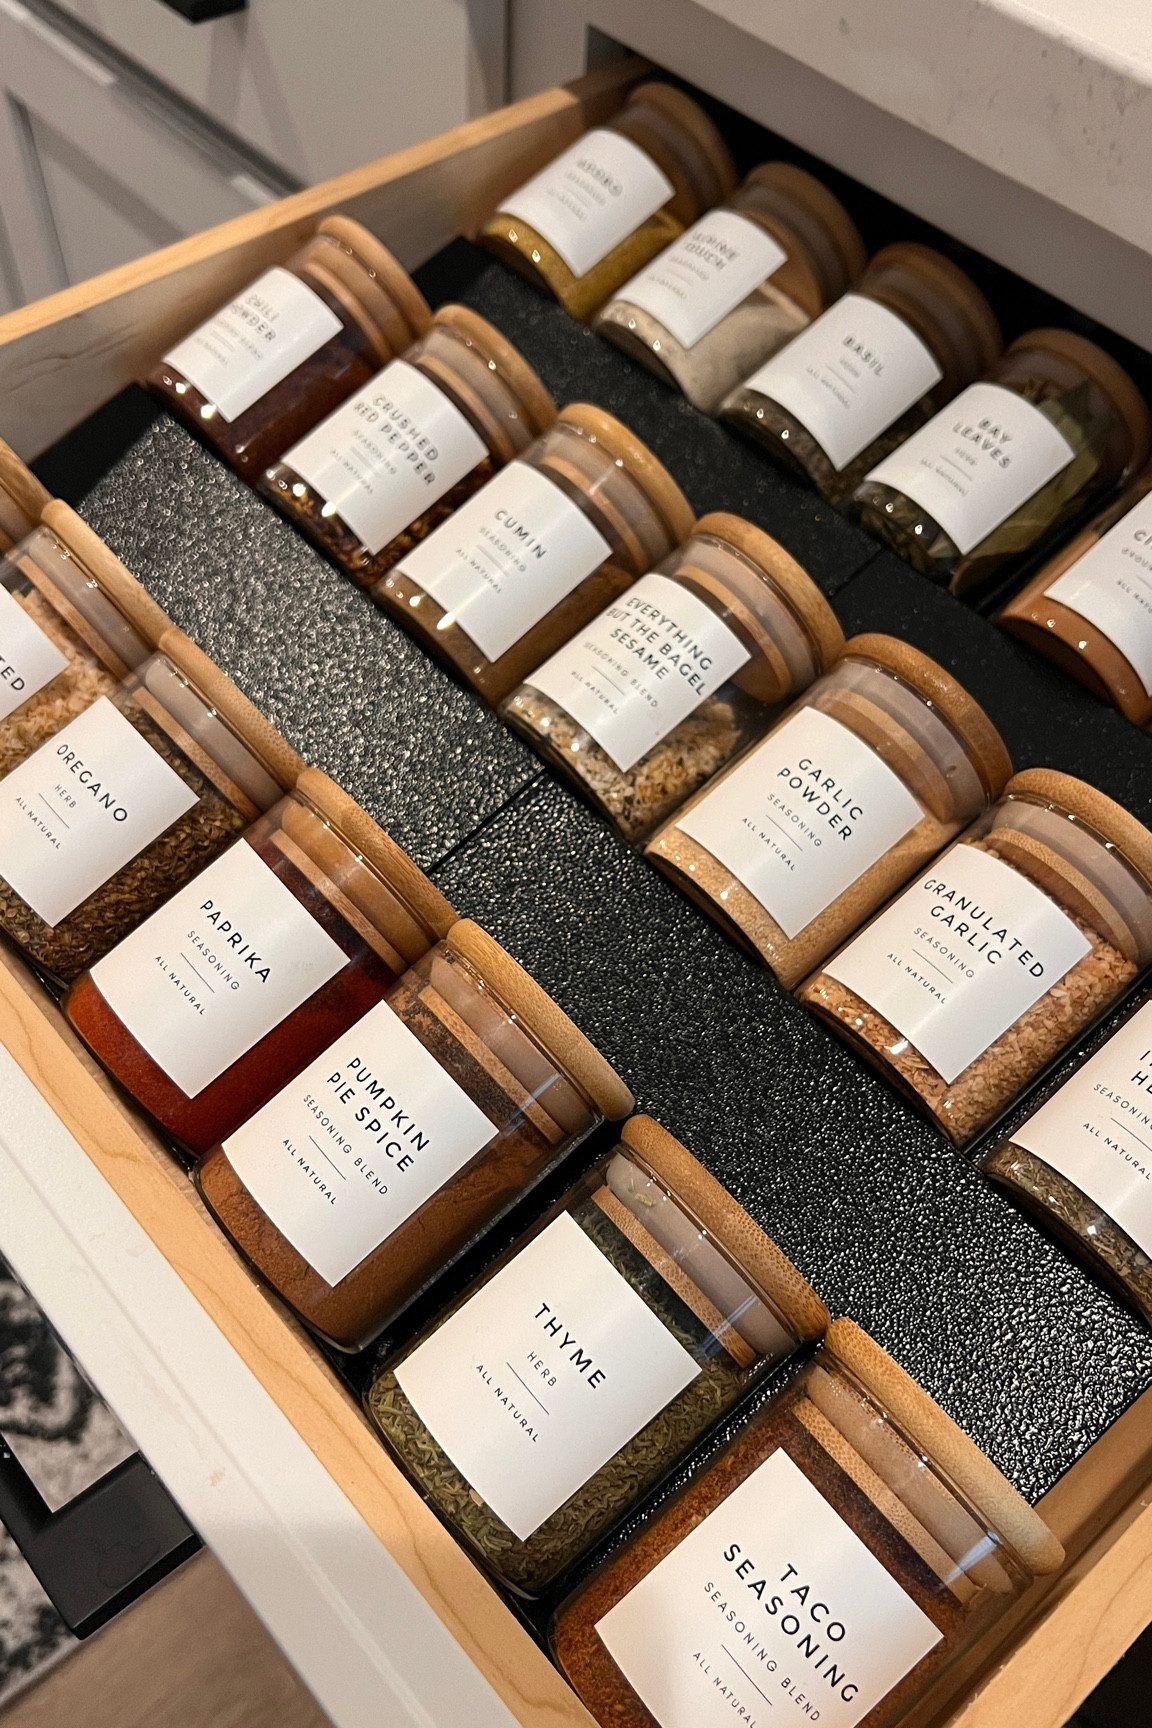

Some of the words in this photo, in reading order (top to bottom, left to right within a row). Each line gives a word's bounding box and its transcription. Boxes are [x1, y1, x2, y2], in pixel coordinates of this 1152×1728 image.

[843, 336, 884, 377] BASIL
[354, 401, 380, 424] RED
[380, 424, 436, 486] PEPPER
[372, 394, 438, 461] CRUSHED
[952, 422, 1011, 469] LEAVES
[978, 418, 1012, 444] BAY
[480, 527, 527, 572] SEASONING
[494, 509, 547, 560] CUMIN
[607, 608, 631, 622] BUT
[631, 618, 660, 644] THE
[659, 643, 708, 696] BAGEL
[610, 628, 670, 680] SESAME
[626, 598, 712, 671] EVERYTHING
[571, 670, 584, 684] ALL
[585, 682, 620, 715] NATURAL
[584, 642, 629, 678] SEASONING
[630, 678, 658, 708] BLEND
[54, 784, 76, 810] HERB
[56, 744, 128, 822] OREGANO
[777, 768, 852, 841] POWDER
[798, 758, 863, 821] GARLIC
[16, 797, 27, 812] ALL
[26, 810, 62, 850] NATURAL
[741, 817, 758, 832] ALL
[758, 832, 796, 871] NATURAL
[767, 794, 822, 847] SEASONING
[200, 900, 272, 984] PAPRIKA
[913, 927, 975, 979] SEASONING
[923, 879, 1044, 978] GRANULATED
[930, 905, 1002, 965] GARLIC
[155, 955, 168, 972] ALL
[168, 972, 206, 1016] NATURAL
[187, 930, 240, 991] SEASONING
[886, 952, 903, 967] ALL
[904, 966, 946, 1004] NATURAL
[326, 1071, 356, 1105] PIE
[354, 1106, 415, 1173] SPICE
[346, 1057, 430, 1152] PUMPKIN
[1093, 1083, 1152, 1130] SEASONIN
[282, 1138, 296, 1156] ALL
[297, 1157, 338, 1206] NATURAL
[303, 1094, 352, 1154] SEASONING
[354, 1157, 389, 1196] BLEND
[1083, 1122, 1100, 1138] ALL
[1104, 1137, 1151, 1180] NATURAL
[526, 1351, 557, 1388] HERB
[534, 1302, 607, 1390] THYME
[476, 1364, 493, 1386] ALL
[494, 1387, 539, 1444] NATURAL
[723, 1544, 859, 1703] SEASONING
[780, 1562, 847, 1643] TACO
[704, 1582, 778, 1673] SEASONING
[780, 1677, 821, 1721] BLEND
[692, 1652, 711, 1674] ALL
[713, 1676, 757, 1728] NATURAL
